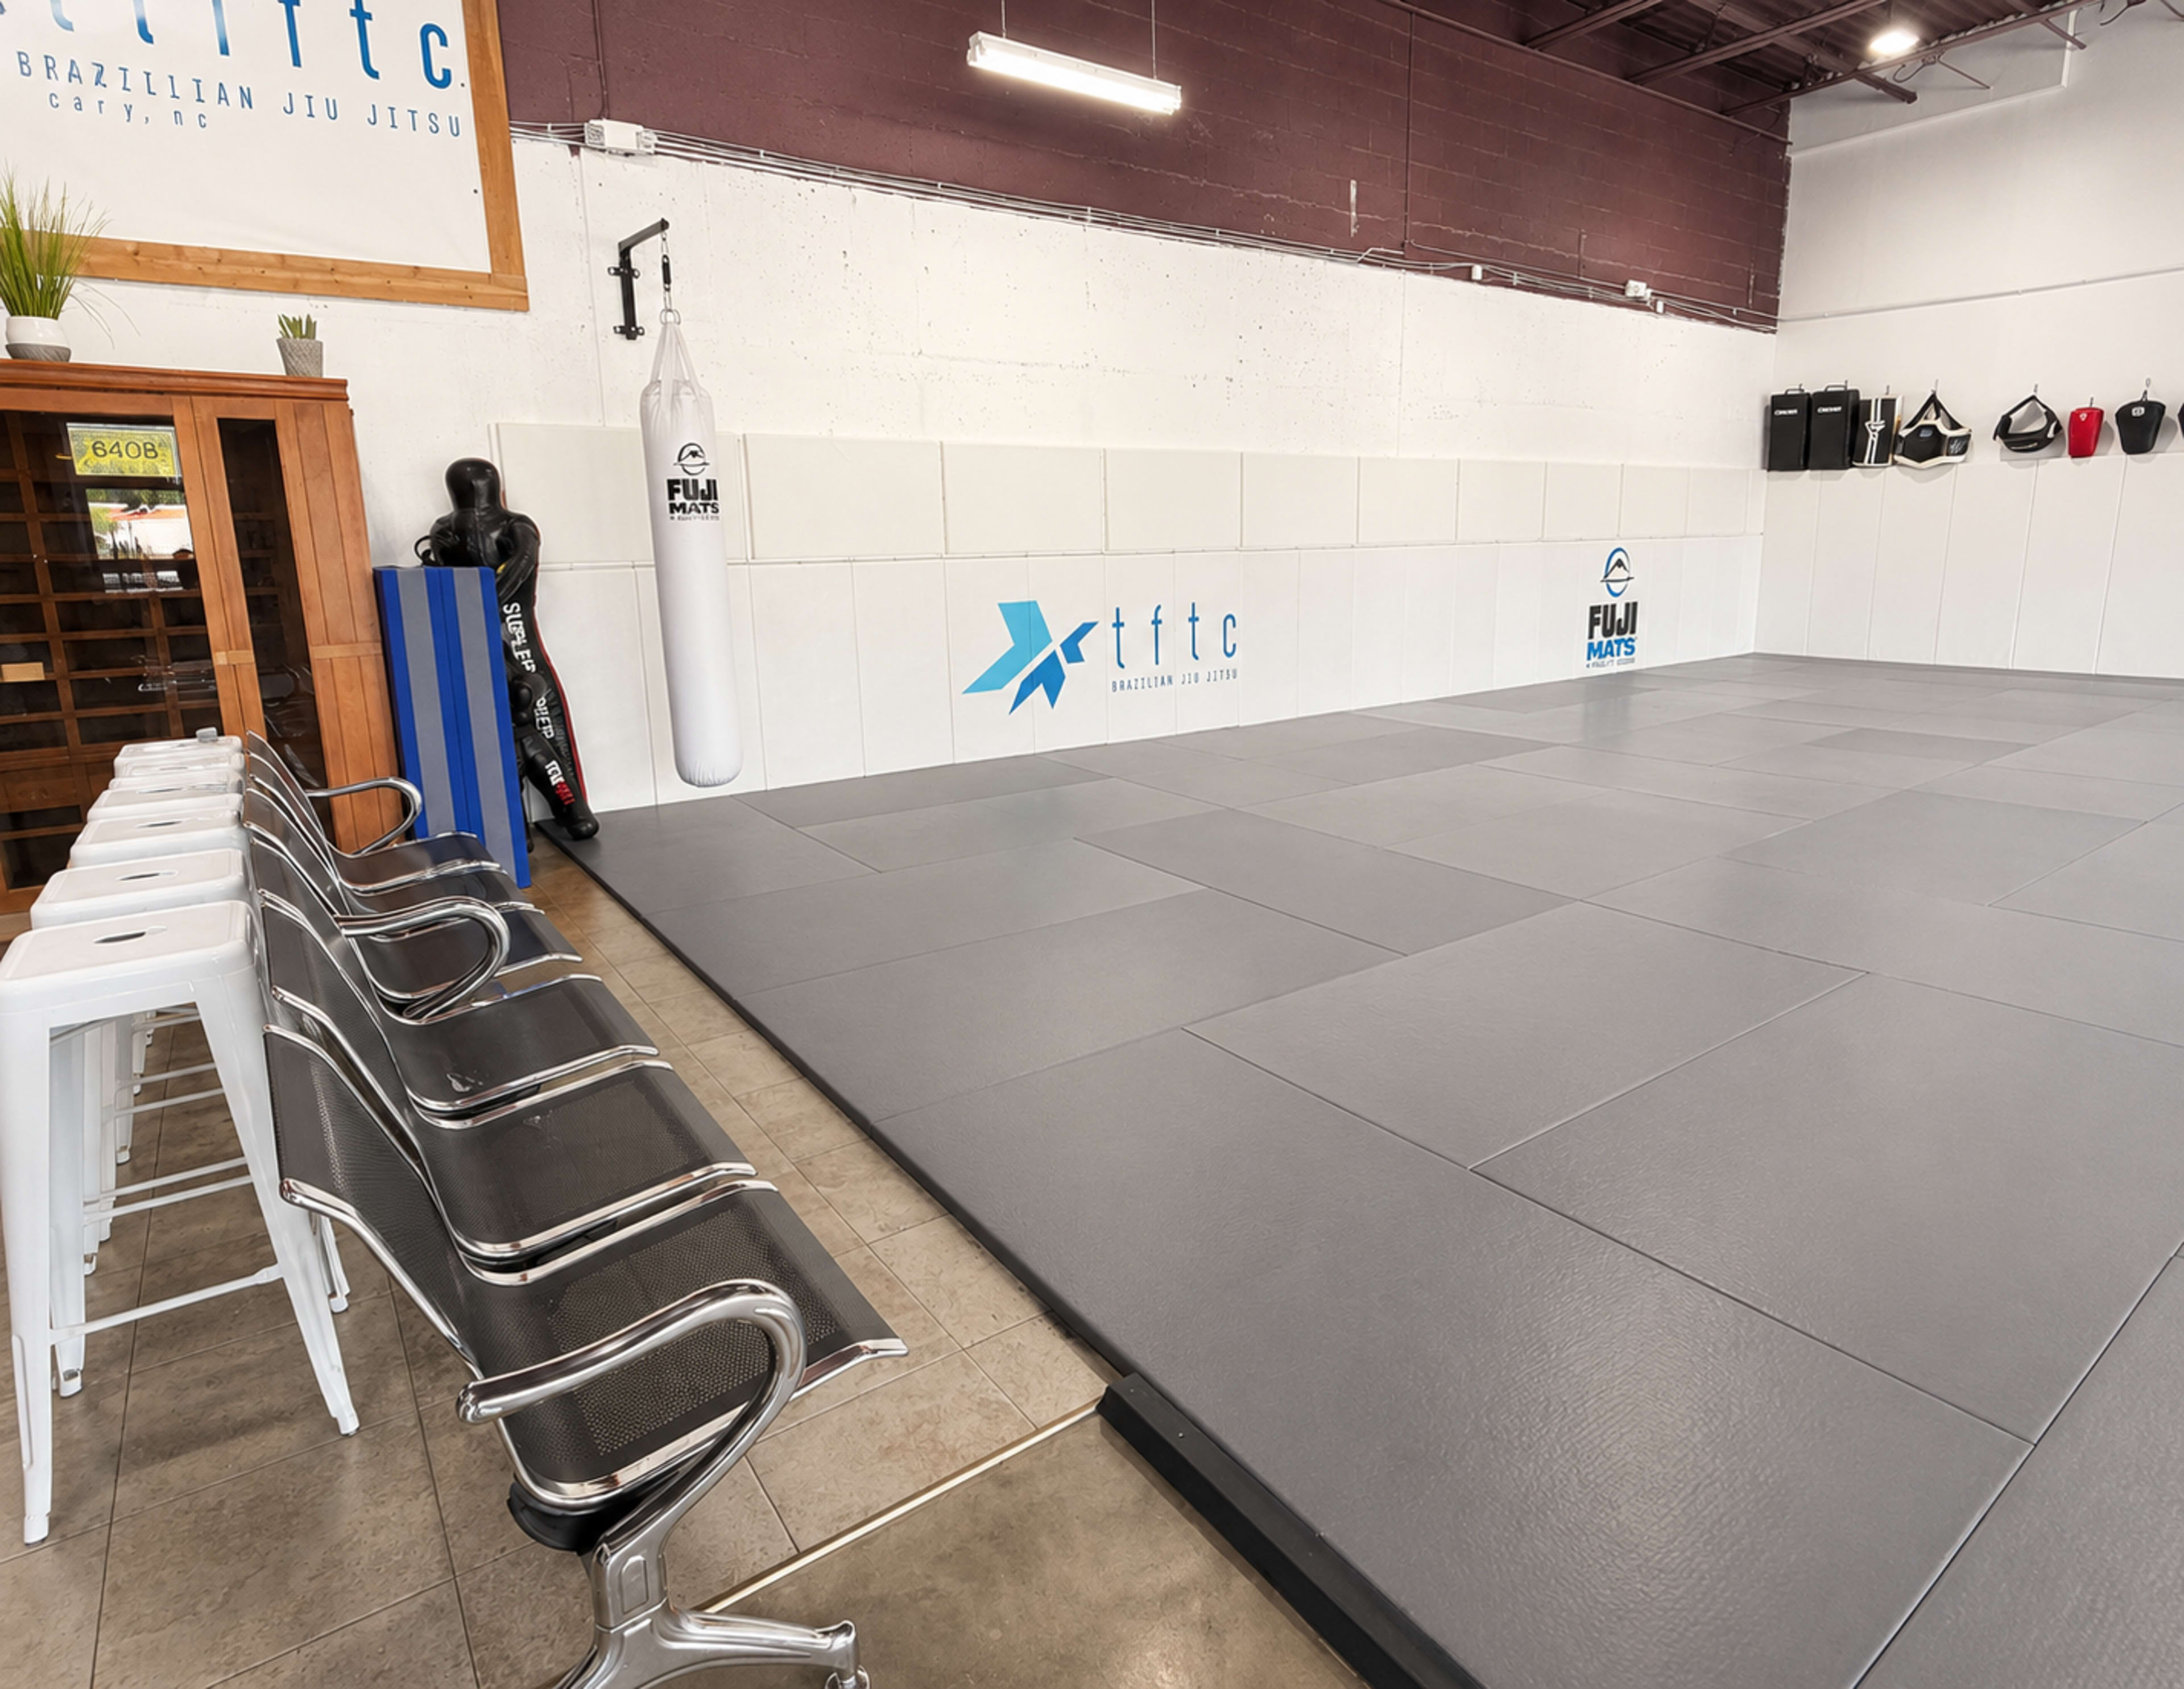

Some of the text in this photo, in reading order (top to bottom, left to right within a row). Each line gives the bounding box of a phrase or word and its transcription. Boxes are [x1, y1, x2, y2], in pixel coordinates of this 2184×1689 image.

[49, 93, 207, 129] cary, nc
[283, 92, 338, 121] JIU
[367, 104, 460, 137] JITSU
[92, 440, 158, 459] 640B
[667, 479, 718, 501] FUJI
[669, 502, 719, 515] MATS
[1588, 601, 1638, 640] FUJI
[1586, 636, 1636, 661] MATS
[1111, 674, 1173, 693] BRAZILIAN
[1206, 669, 1238, 682] JITSU
